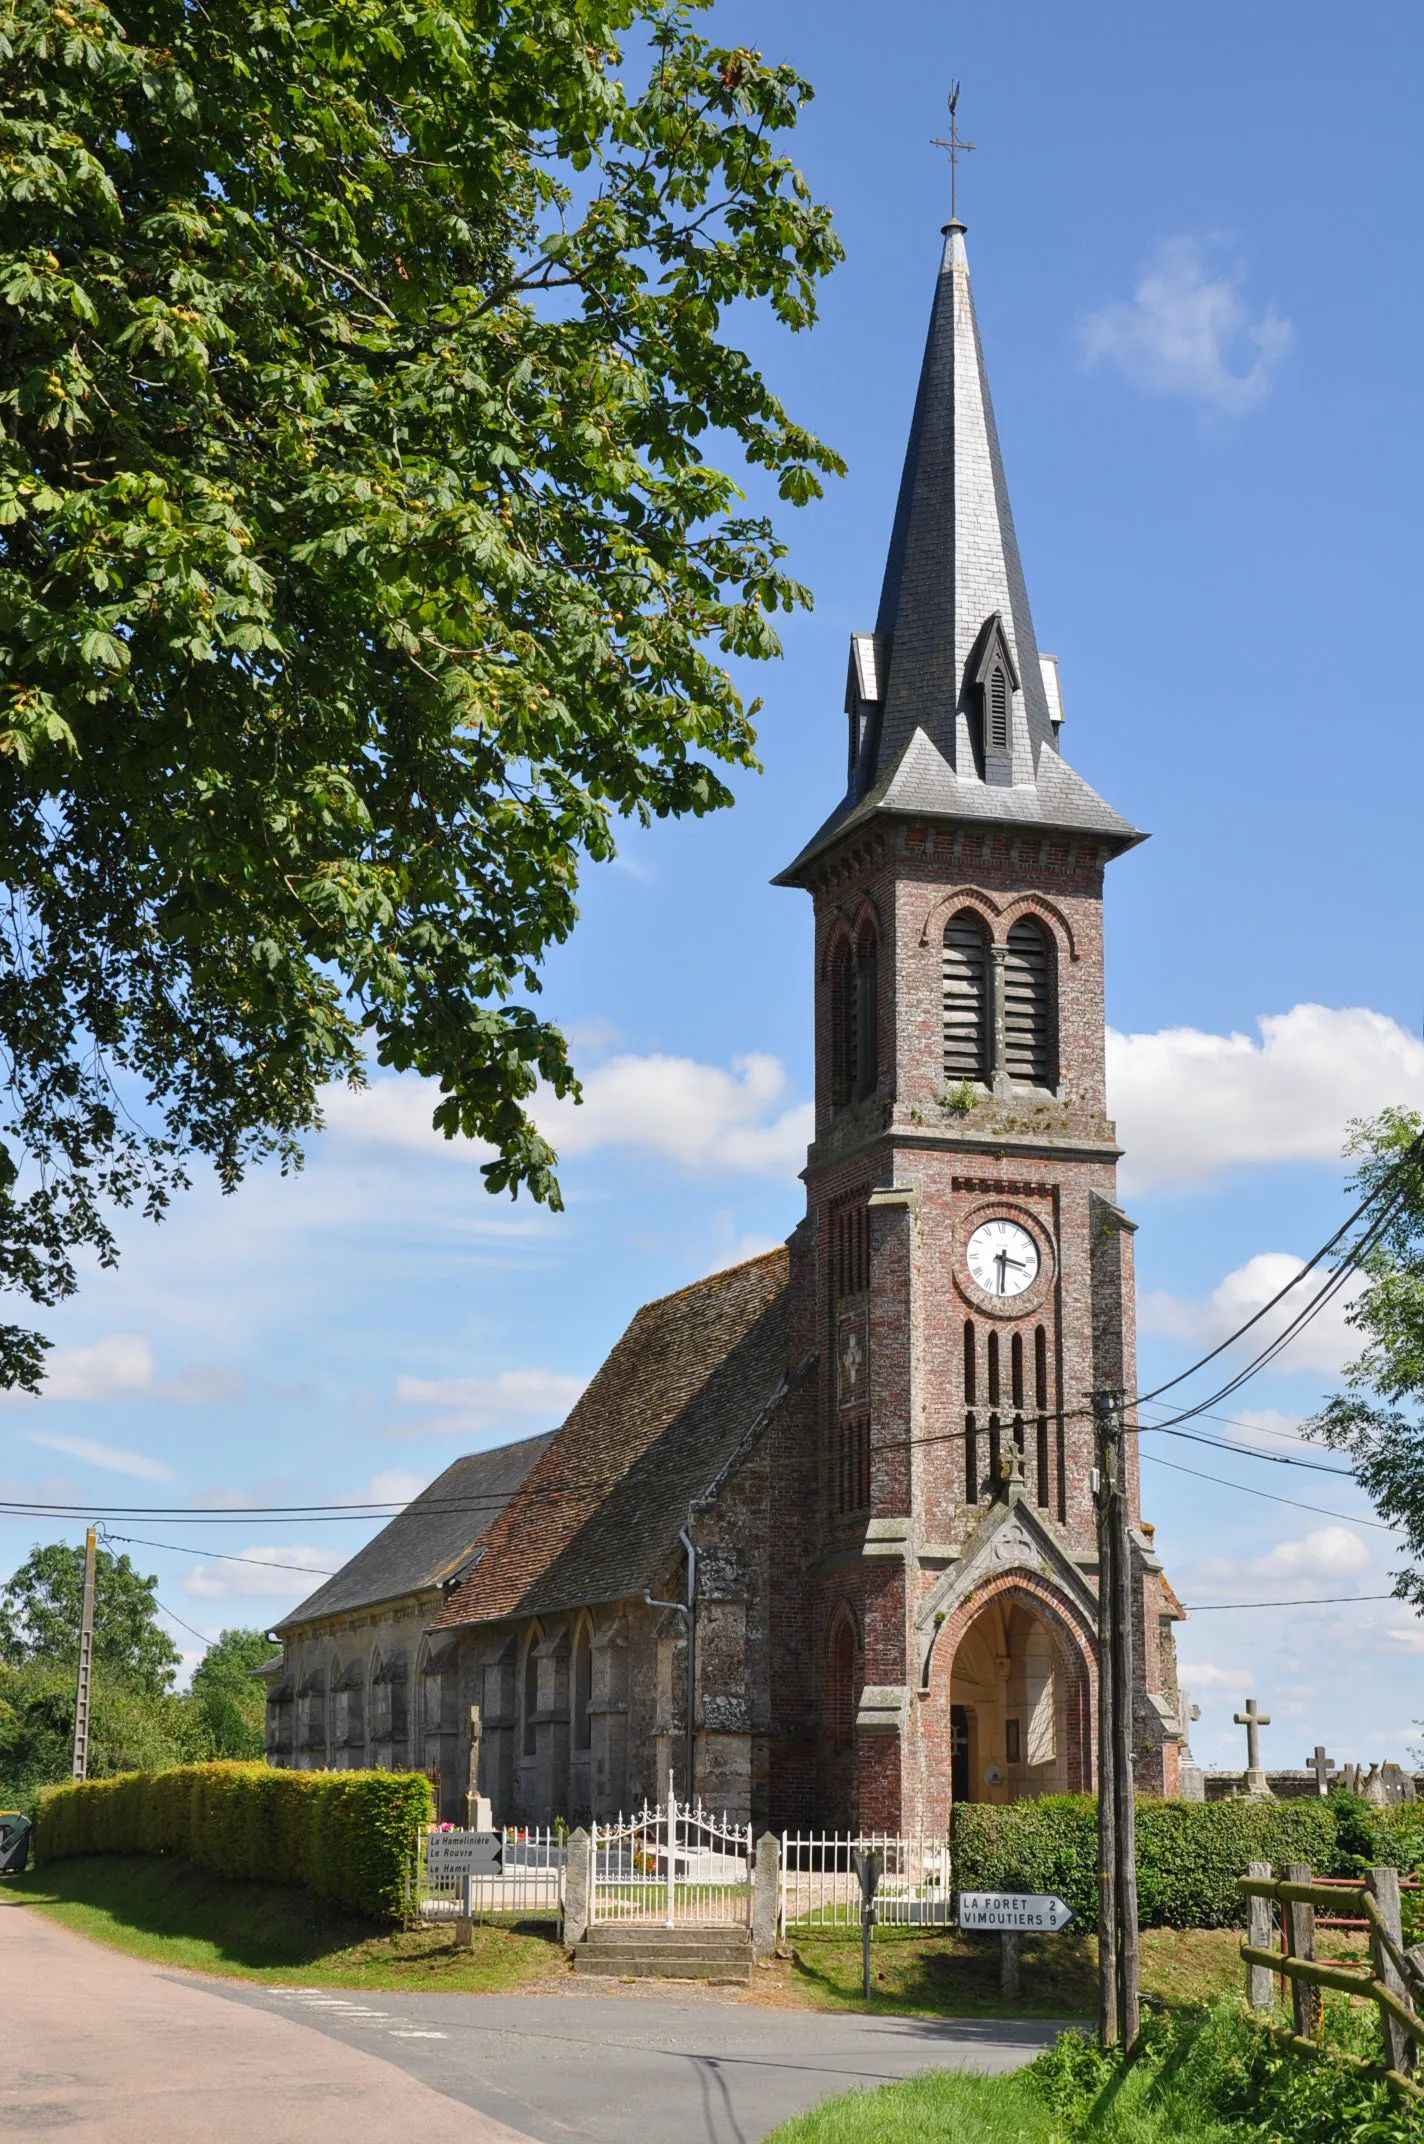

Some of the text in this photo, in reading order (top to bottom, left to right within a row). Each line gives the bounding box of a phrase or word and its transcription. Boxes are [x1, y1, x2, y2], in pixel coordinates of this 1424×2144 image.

[430, 1836, 490, 1846] La Hamelinière
[430, 1848, 473, 1857] Le Rouvre
[430, 1863, 471, 1873] Le Hamel
[963, 1897, 1056, 1911] LA FORÊT 2
[964, 1912, 1057, 1926] VIMOUTIERS 9
